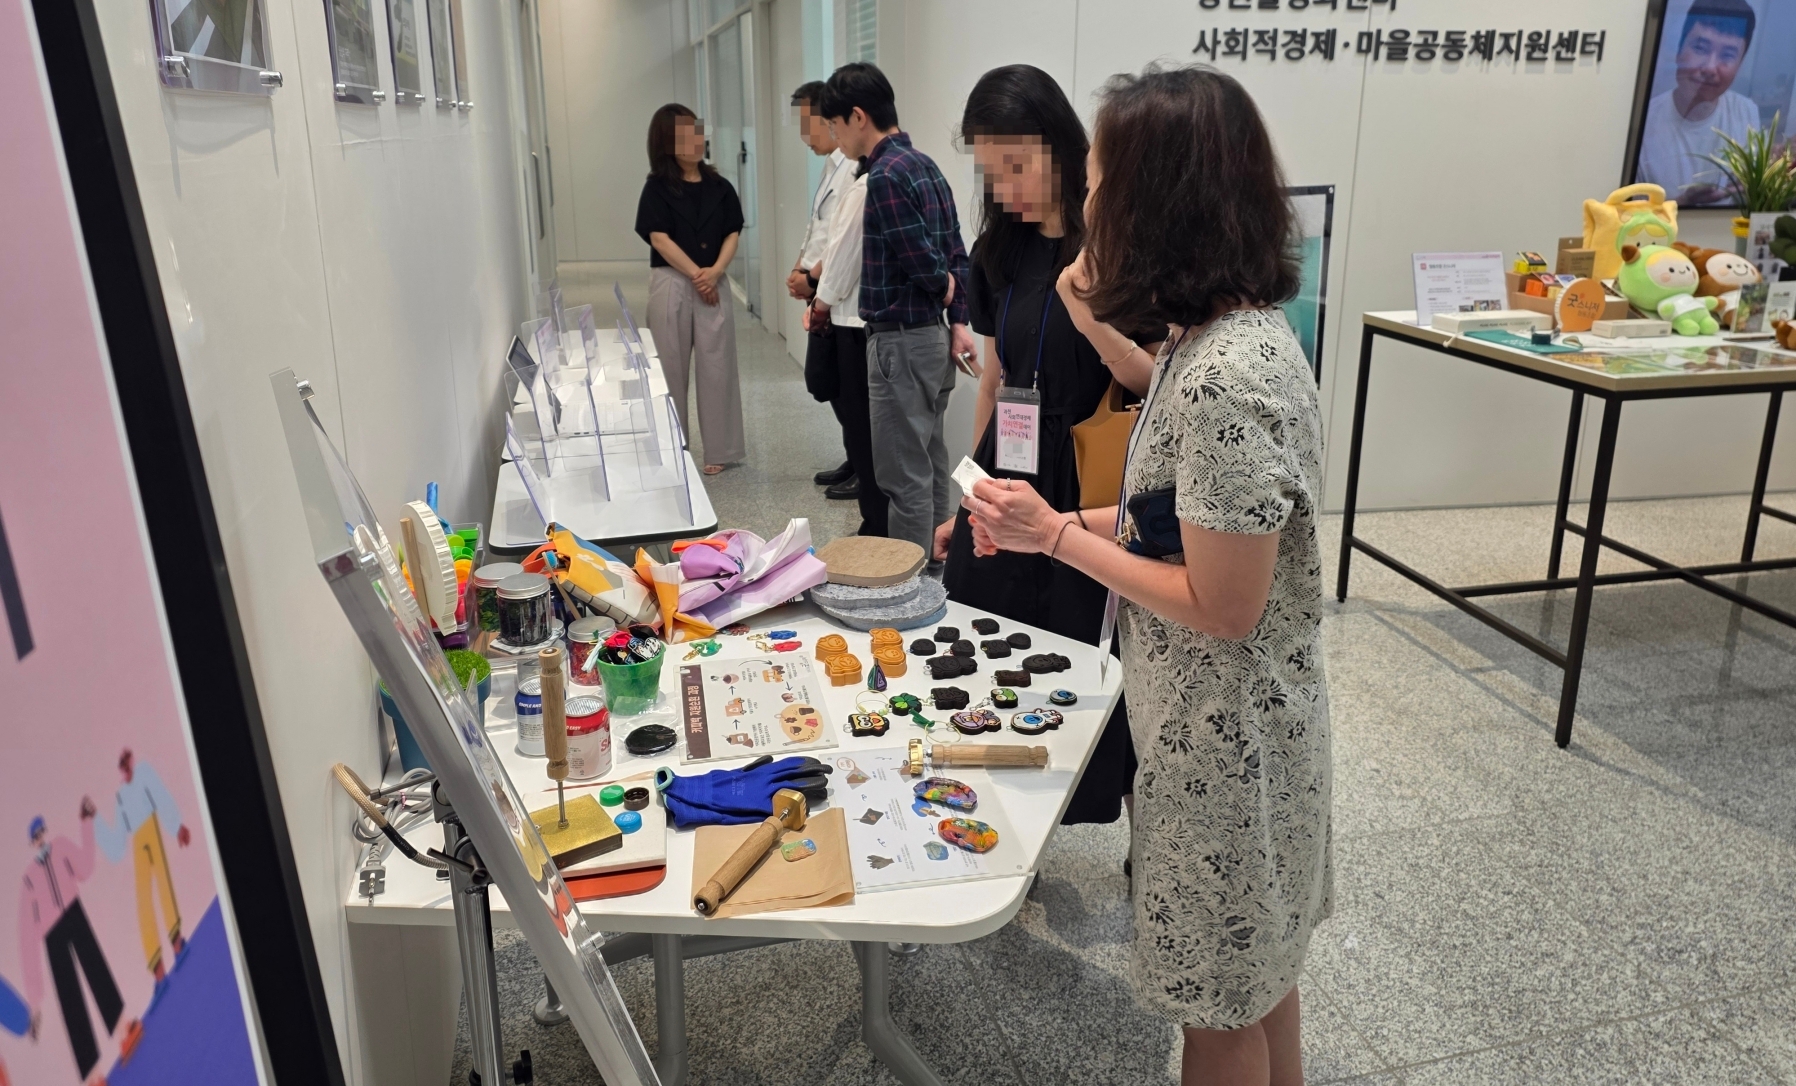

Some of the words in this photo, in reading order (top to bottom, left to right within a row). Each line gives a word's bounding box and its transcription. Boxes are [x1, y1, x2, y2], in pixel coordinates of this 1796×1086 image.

[1192, 27, 1606, 62] 사회적경제·마을공동체지원센터
[688, 696, 702, 716] 자원순환
[690, 717, 704, 734] 커피박
